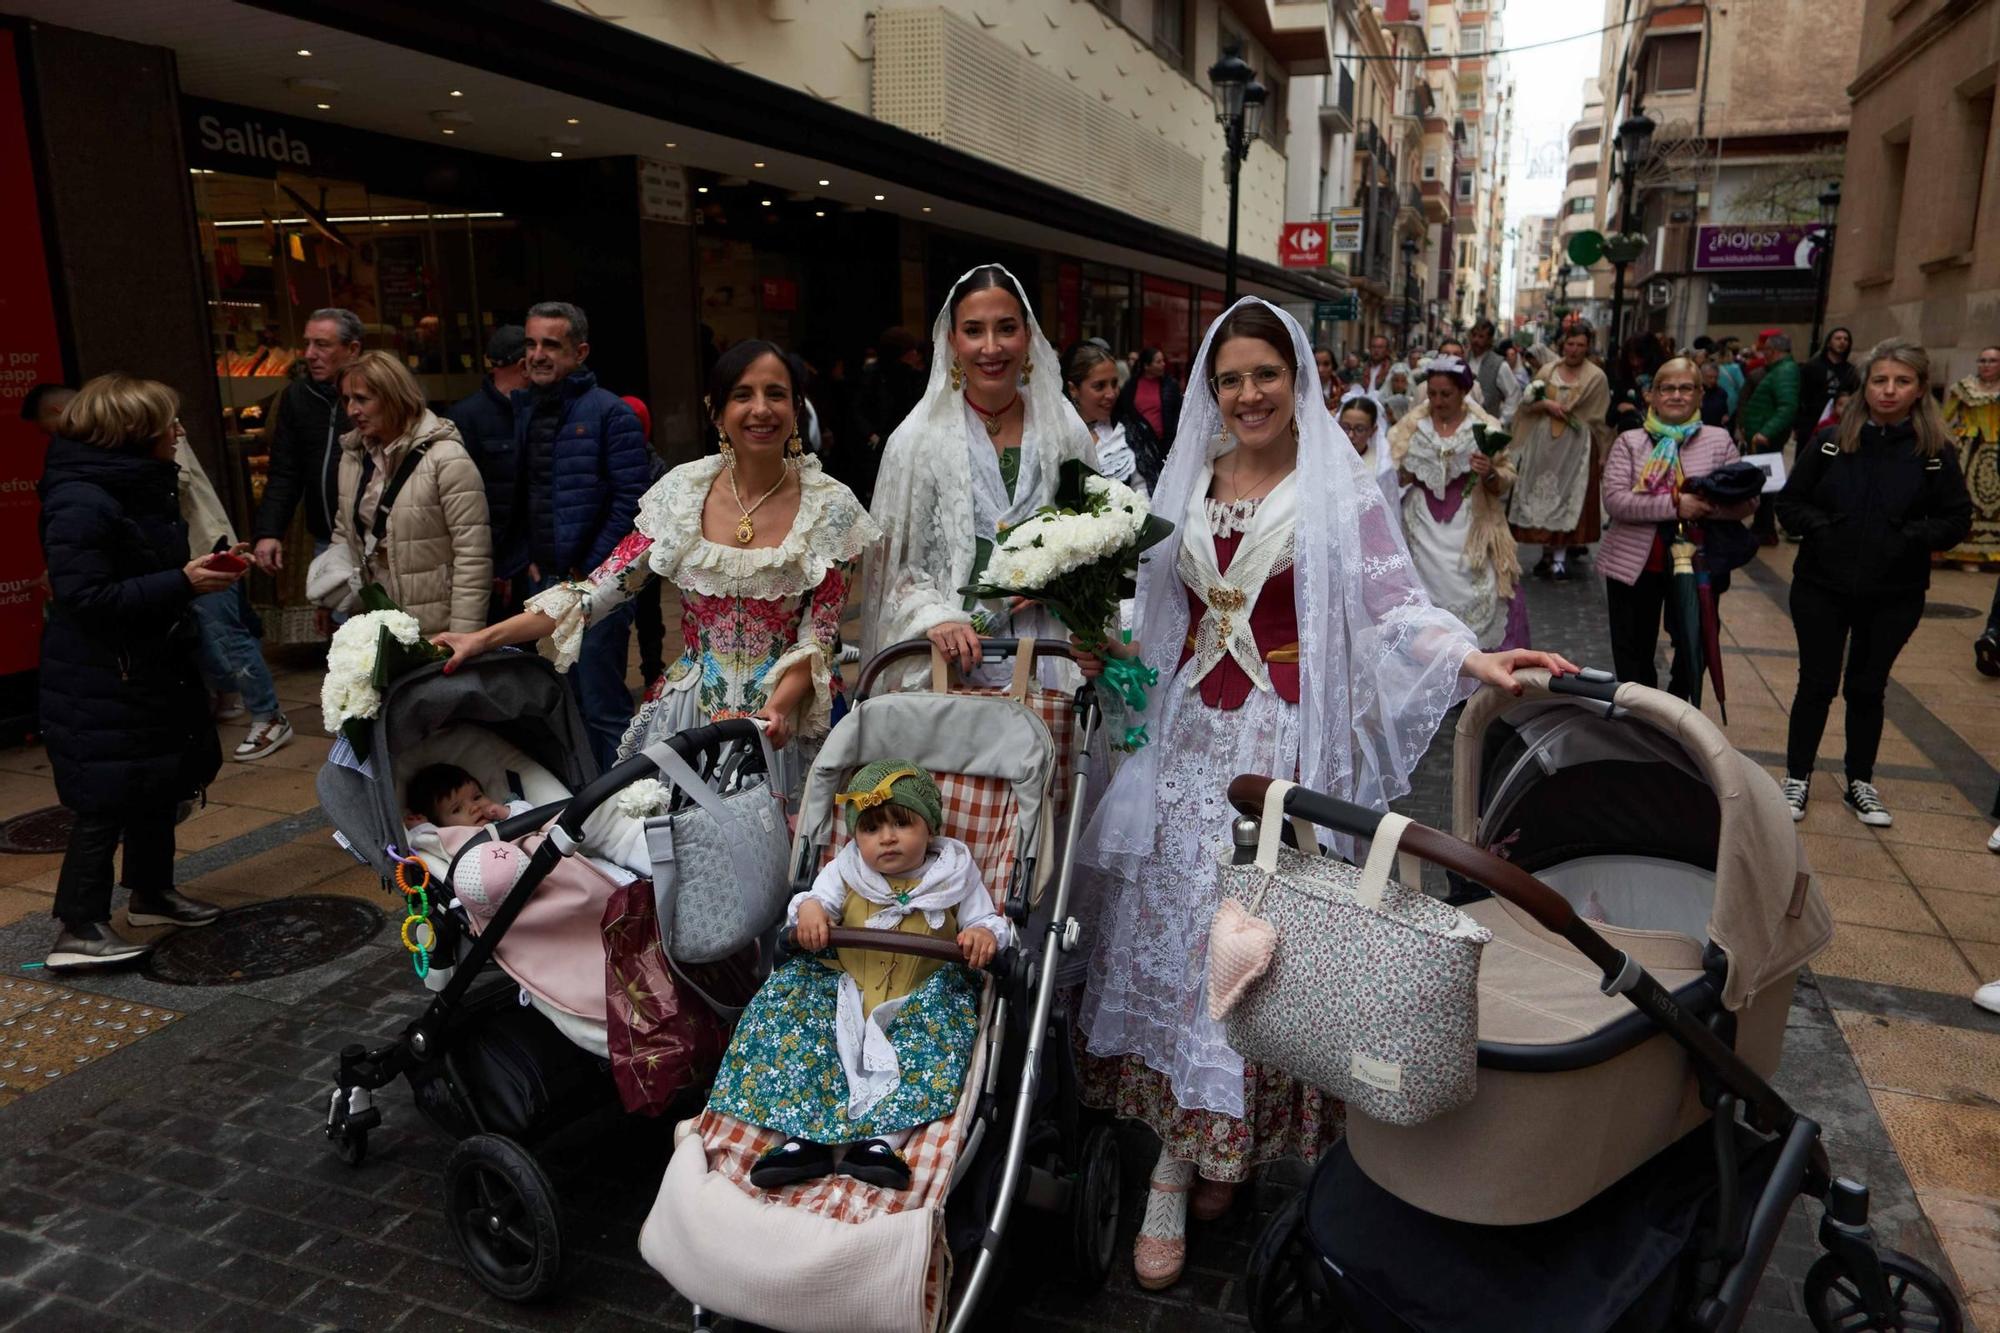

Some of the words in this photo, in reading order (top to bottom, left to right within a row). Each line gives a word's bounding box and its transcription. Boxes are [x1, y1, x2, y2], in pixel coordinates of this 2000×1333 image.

[197, 114, 311, 166] Salida
[1708, 231, 1781, 251] ¿PIOJOS?
[9, 352, 40, 367] por
[1651, 987, 1680, 1021] VISTA
